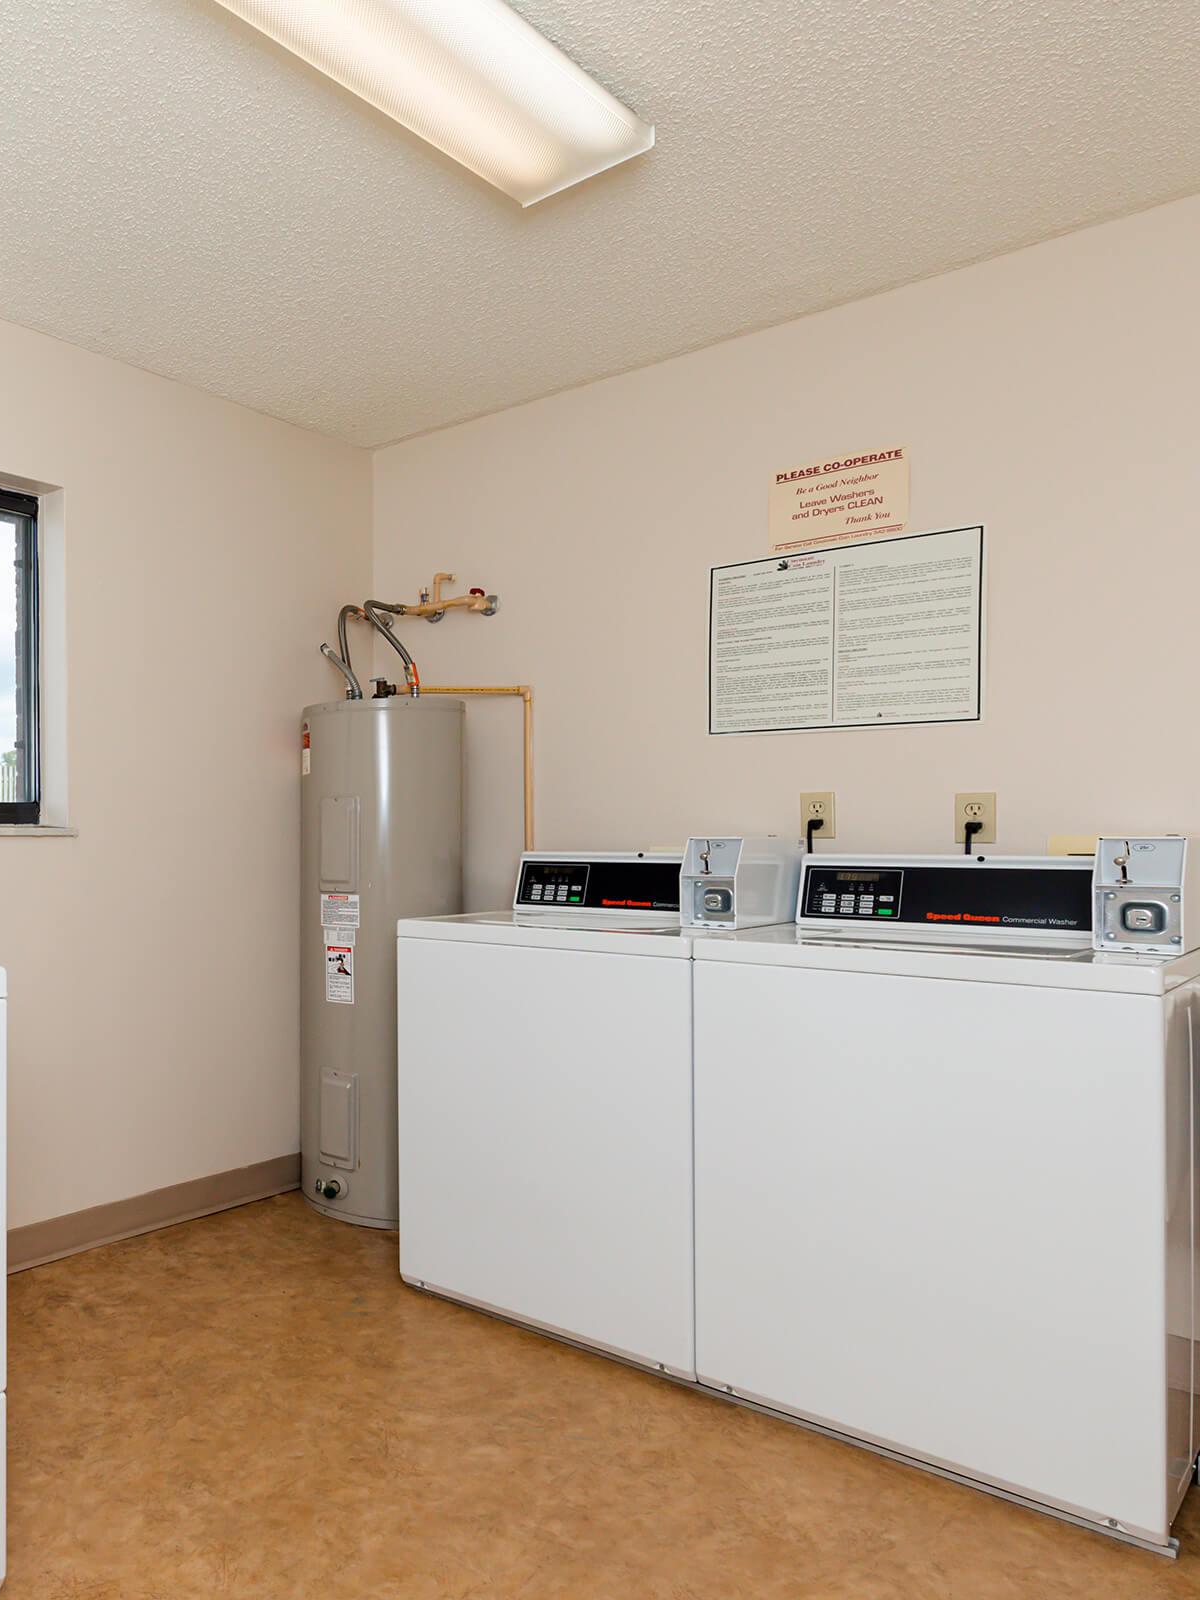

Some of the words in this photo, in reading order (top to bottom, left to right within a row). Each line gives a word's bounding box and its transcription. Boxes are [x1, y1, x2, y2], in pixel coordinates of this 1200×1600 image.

[776, 466, 820, 482] PLEASE
[824, 449, 902, 471] CO-OPERATE
[796, 487, 807, 495] Be
[816, 481, 838, 491] Good
[840, 473, 879, 486] Neighbor
[792, 510, 809, 520] and
[812, 504, 844, 517] Dryers
[847, 496, 883, 509] CLEAN
[800, 499, 826, 509] Leave
[830, 488, 875, 502] Washers
[845, 511, 872, 524] Thank
[874, 511, 891, 520] You
[927, 912, 961, 920] Speed
[963, 913, 1000, 922] Queen
[1002, 916, 1047, 925] Commercial
